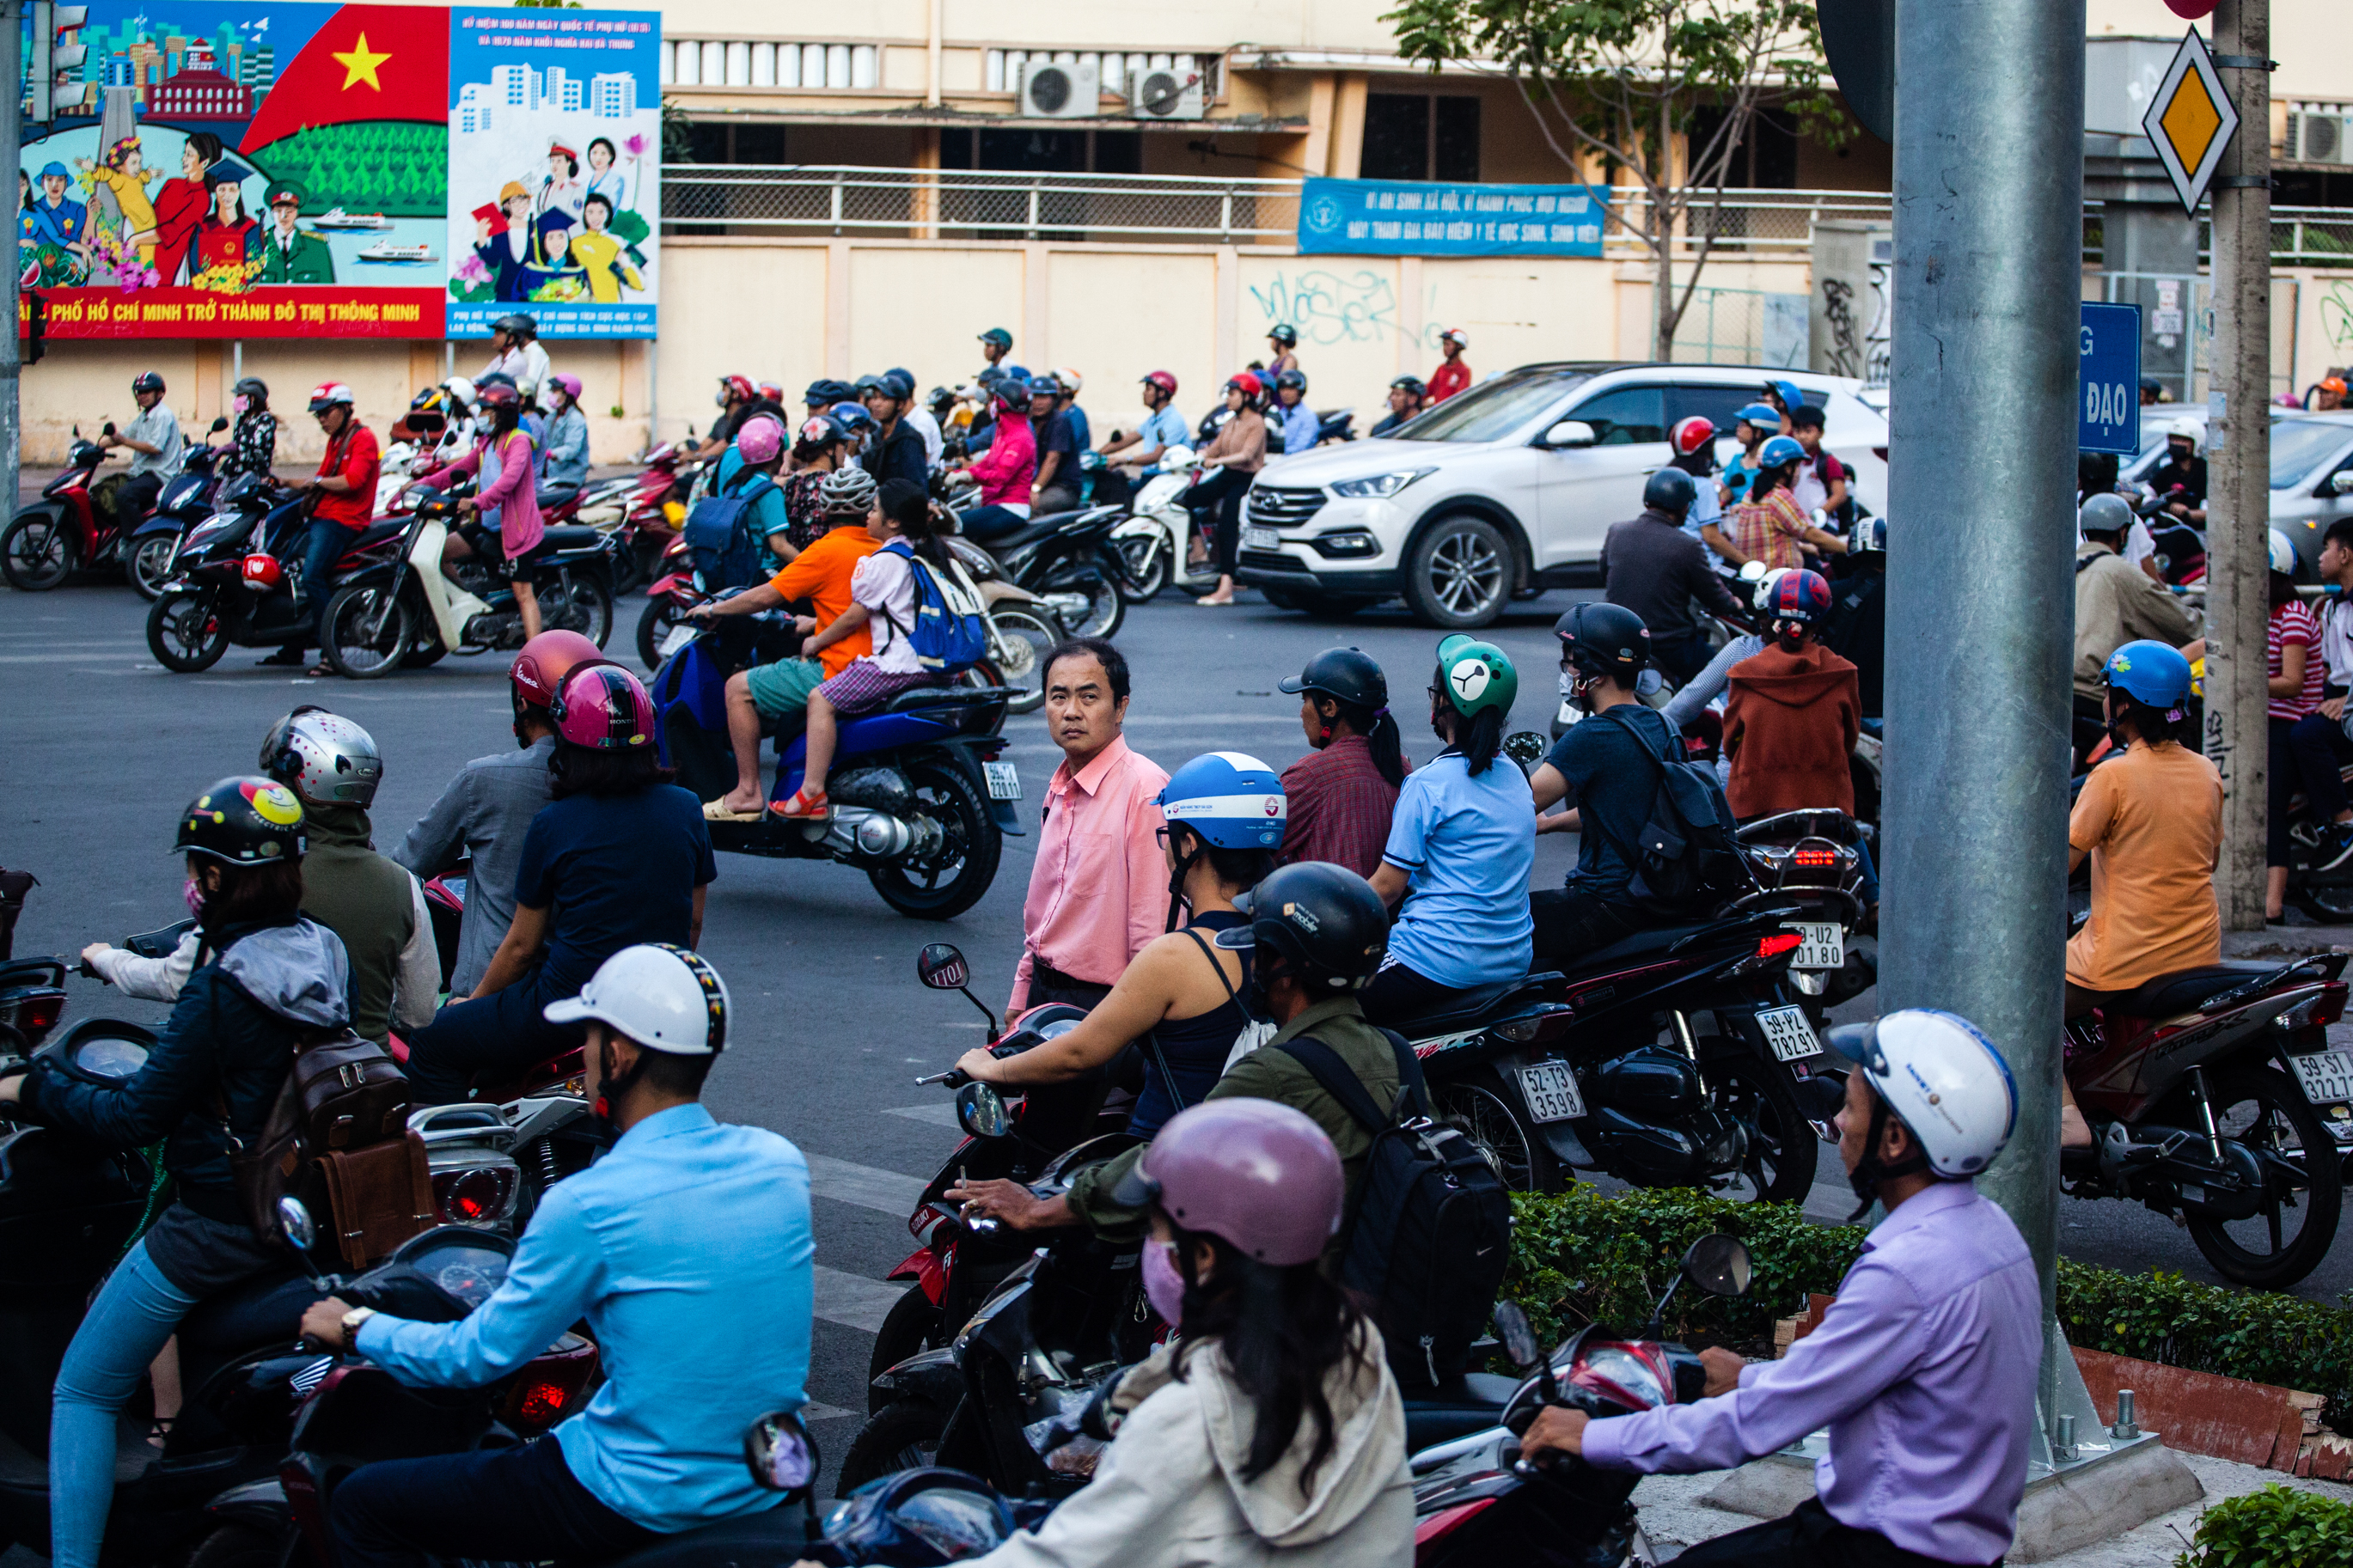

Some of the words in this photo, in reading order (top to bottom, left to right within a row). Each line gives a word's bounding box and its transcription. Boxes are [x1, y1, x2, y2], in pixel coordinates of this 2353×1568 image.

[515, 18, 535, 30] NĂM
[535, 18, 559, 31] NGÀY
[560, 19, 583, 32] QUỐC
[584, 19, 596, 32] TẾ
[596, 21, 612, 34] PHỤ
[512, 35, 533, 47] NĂM
[578, 38, 593, 49] HAI
[593, 37, 606, 49] BÀ
[1378, 192, 1396, 210] AN
[1396, 192, 1423, 210] SINH
[1371, 221, 1402, 240] THAM
[1403, 221, 1421, 240] GIA
[1476, 223, 1482, 241] Y
[1485, 219, 1496, 241] TẾ
[1498, 223, 1519, 244] HỌC
[1550, 223, 1575, 243] SINH
[52, 297, 84, 321] PHỐ
[88, 296, 109, 321] HỒ
[113, 300, 140, 321] CHÍ
[143, 303, 181, 321] MINH
[186, 297, 217, 321] TRỞ
[220, 299, 271, 321] THÀNH
[274, 299, 297, 321] ĐÔ
[299, 303, 326, 325] THỊ
[327, 299, 379, 321] THÔNG
[381, 303, 420, 321] MINH
[2087, 381, 2127, 436] ĐẠO
[516, 663, 539, 688] Vespa
[1293, 911, 1318, 931] mobile
[1790, 926, 1833, 943] 9-U2
[1797, 946, 1839, 964] 01.80
[1763, 1010, 1804, 1035] 59-P2
[1771, 1031, 1818, 1059] 782.91
[2298, 1053, 2345, 1077] 59-S1
[1525, 1066, 1568, 1093] 52-T3
[1536, 1091, 1578, 1117] 3598
[911, 1209, 930, 1232] SUZUKI
